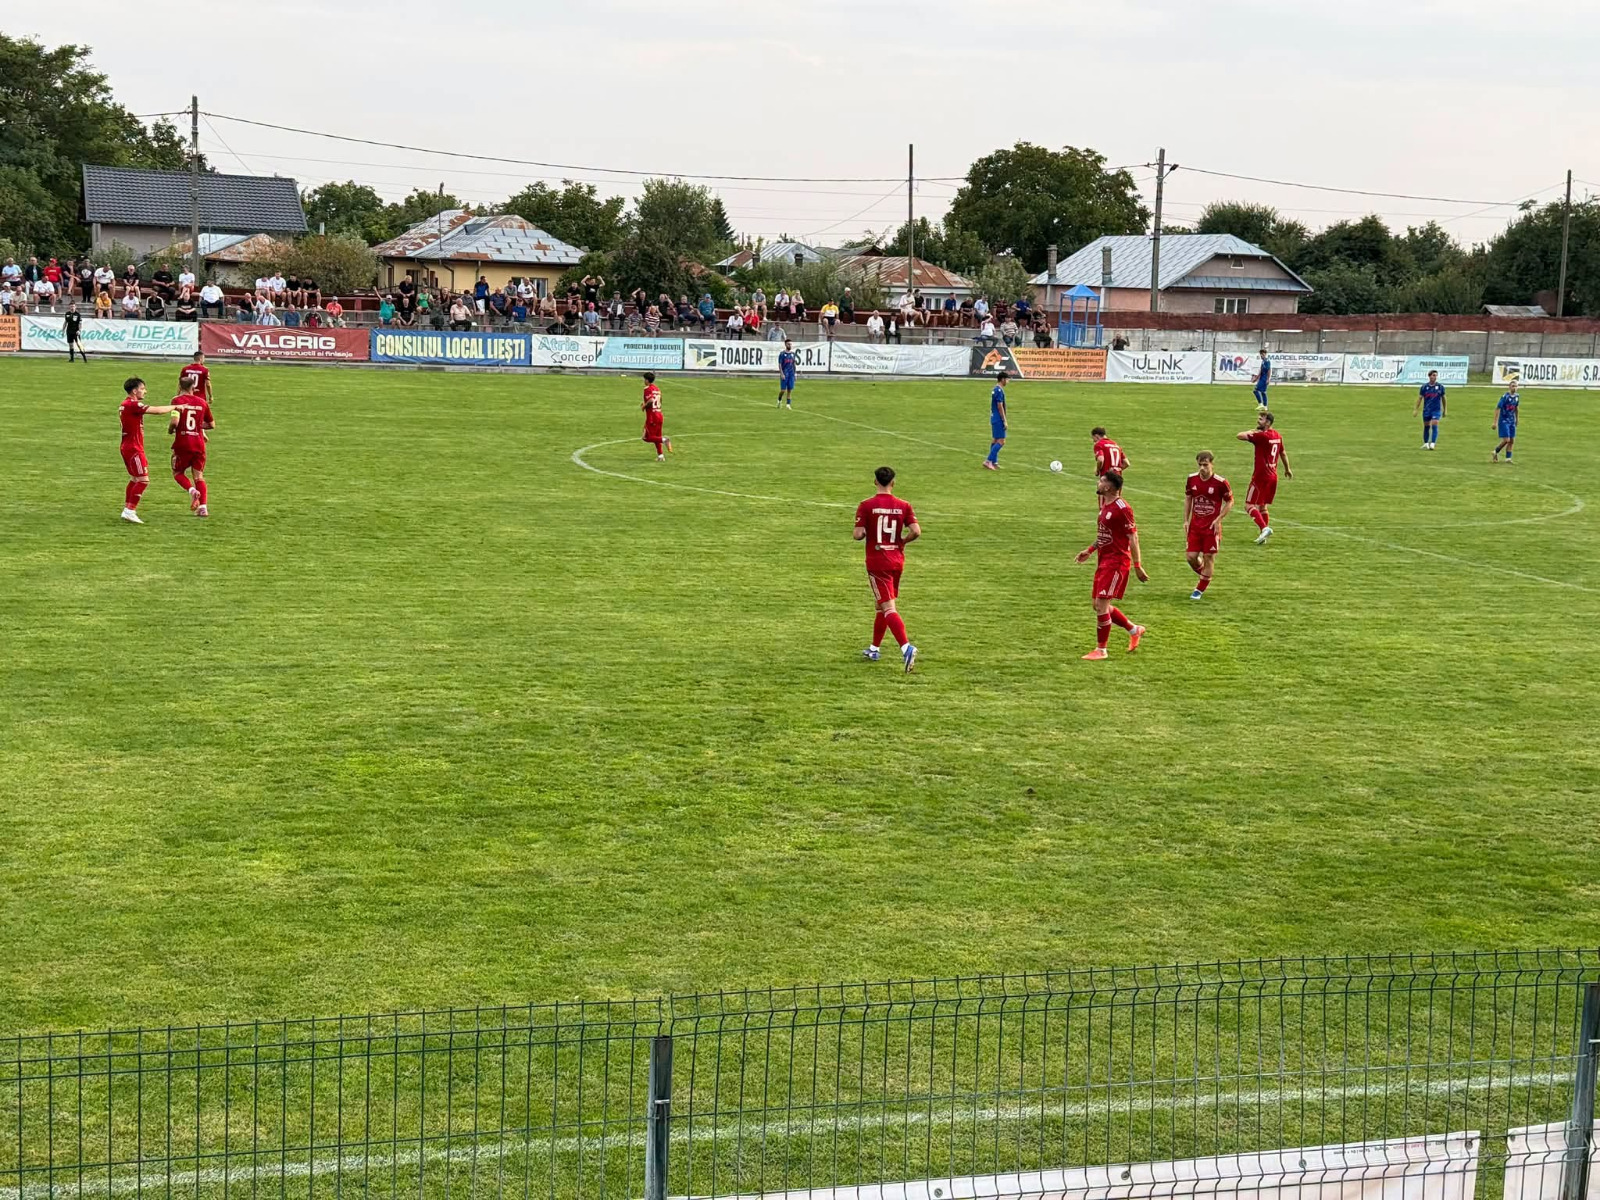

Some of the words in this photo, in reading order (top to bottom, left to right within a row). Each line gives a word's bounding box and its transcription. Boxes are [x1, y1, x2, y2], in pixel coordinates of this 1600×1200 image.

[27, 325, 127, 341] Supearket
[132, 325, 188, 340] IDEAL
[231, 334, 336, 350] VALGRIG
[376, 334, 443, 357] CONSILIUL
[445, 337, 484, 359] LOCAL
[538, 336, 580, 351] Atria
[720, 347, 763, 365] TOADER
[1132, 354, 1183, 373] IULINK
[1350, 356, 1384, 370] Atria
[1523, 363, 1557, 380] TOADER
[186, 410, 196, 430] 6
[1109, 447, 1120, 467] 17
[1271, 443, 1278, 464] 9
[876, 515, 897, 543] 14
